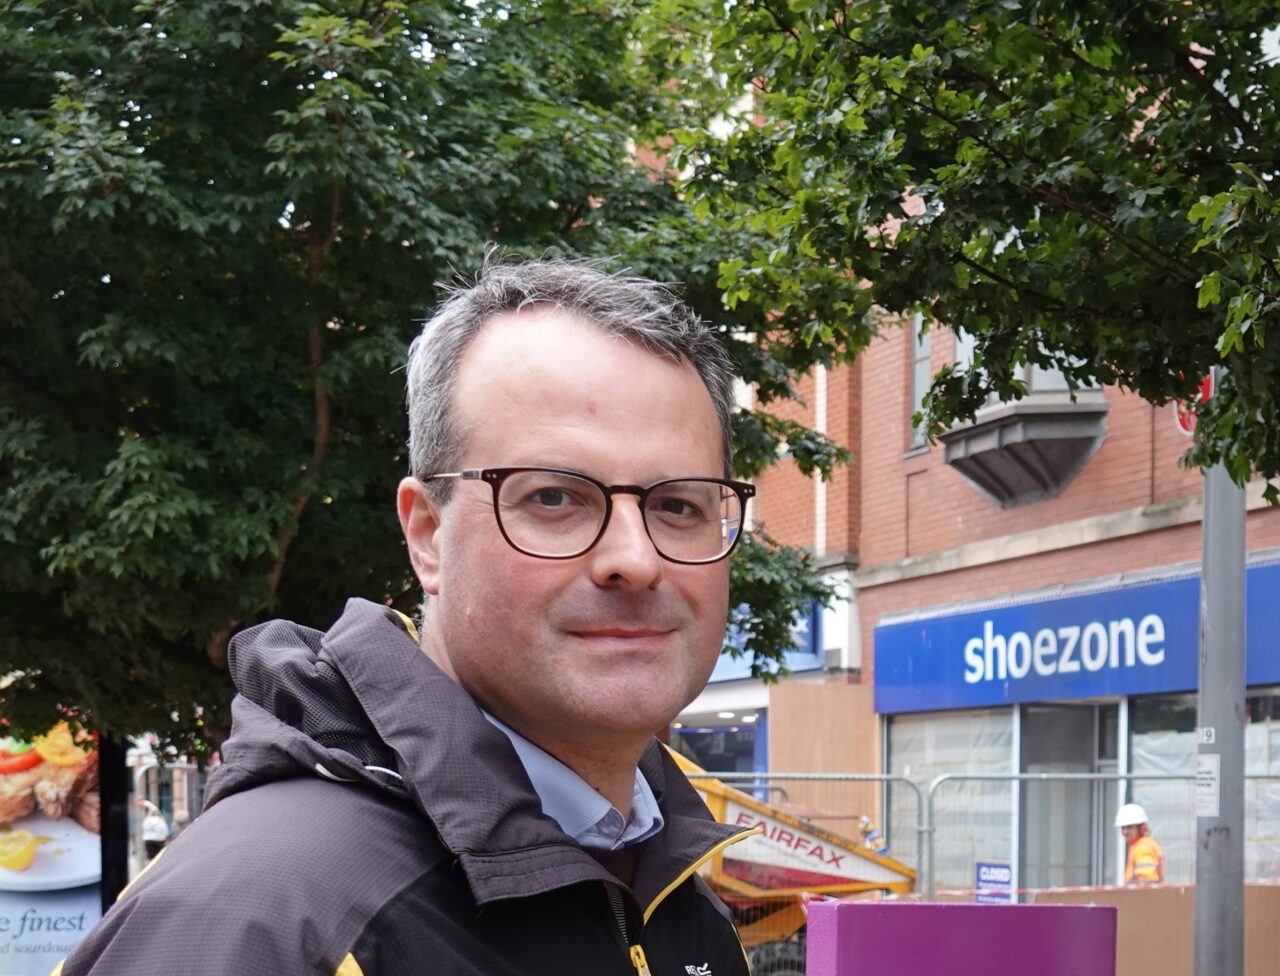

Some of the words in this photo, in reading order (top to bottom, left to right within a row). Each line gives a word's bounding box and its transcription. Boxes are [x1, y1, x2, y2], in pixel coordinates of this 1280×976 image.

[964, 613, 1165, 684] shoezone
[736, 812, 846, 868] FAIRFAX
[11, 908, 86, 939] finest
